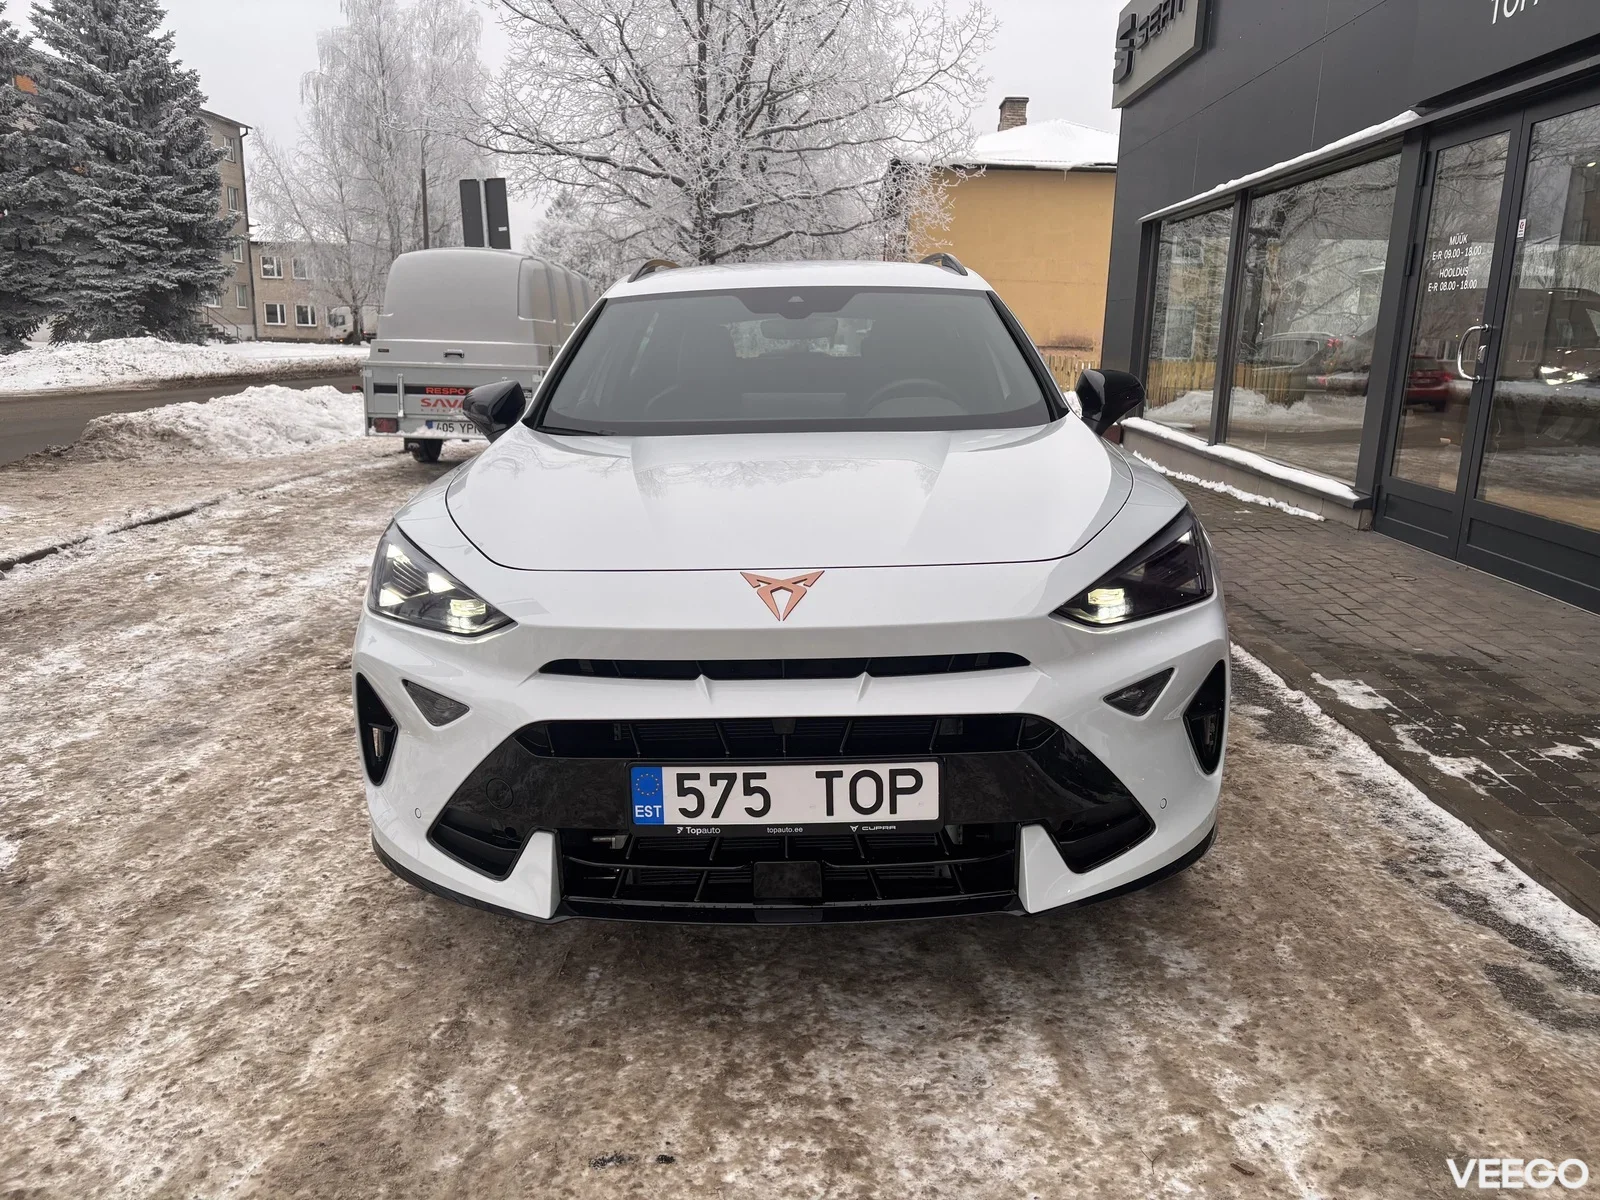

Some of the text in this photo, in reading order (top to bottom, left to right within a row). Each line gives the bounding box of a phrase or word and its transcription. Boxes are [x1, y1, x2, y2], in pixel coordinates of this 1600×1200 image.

[1449, 232, 1468, 245] MÜÜK
[1444, 248, 1460, 259] 09.00
[1464, 245, 1482, 257] 18.00
[1439, 266, 1469, 278] HOOLDUS
[1440, 281, 1456, 291] 08.00
[1460, 279, 1477, 290] 18.00
[426, 387, 466, 395] RESPO
[676, 768, 923, 818] 575 TOP
[635, 805, 662, 818] EST
[686, 826, 721, 836] Topauto
[767, 826, 803, 835] topauto.ee
